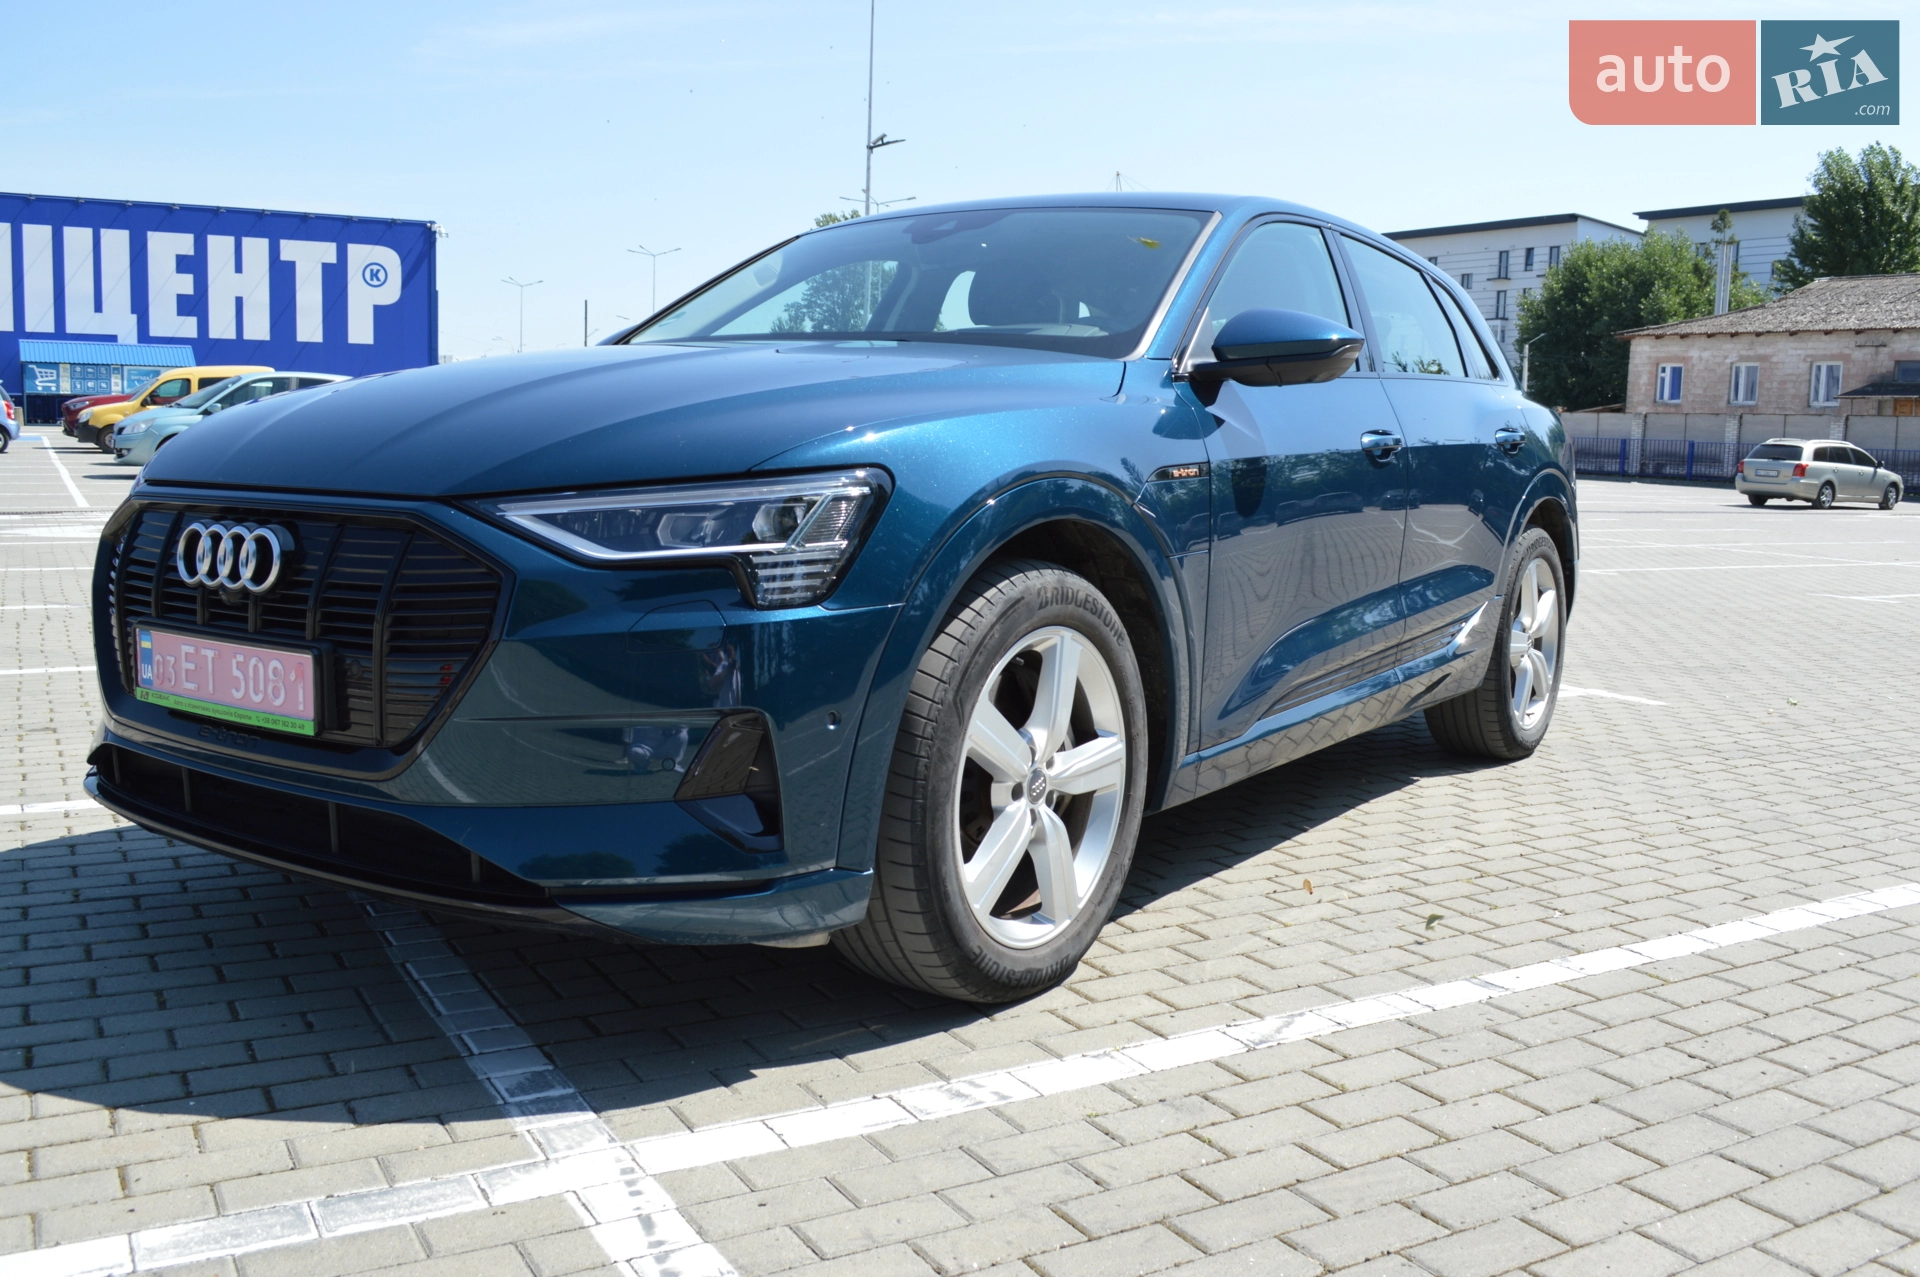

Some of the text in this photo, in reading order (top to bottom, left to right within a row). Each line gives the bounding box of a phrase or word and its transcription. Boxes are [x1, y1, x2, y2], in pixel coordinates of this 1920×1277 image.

[1037, 585, 1126, 647] BRIDGESTONE
[142, 664, 153, 680] UA
[181, 643, 219, 694] ET
[231, 652, 304, 711] 5081
[972, 945, 1071, 989] BRIDGESTONE
